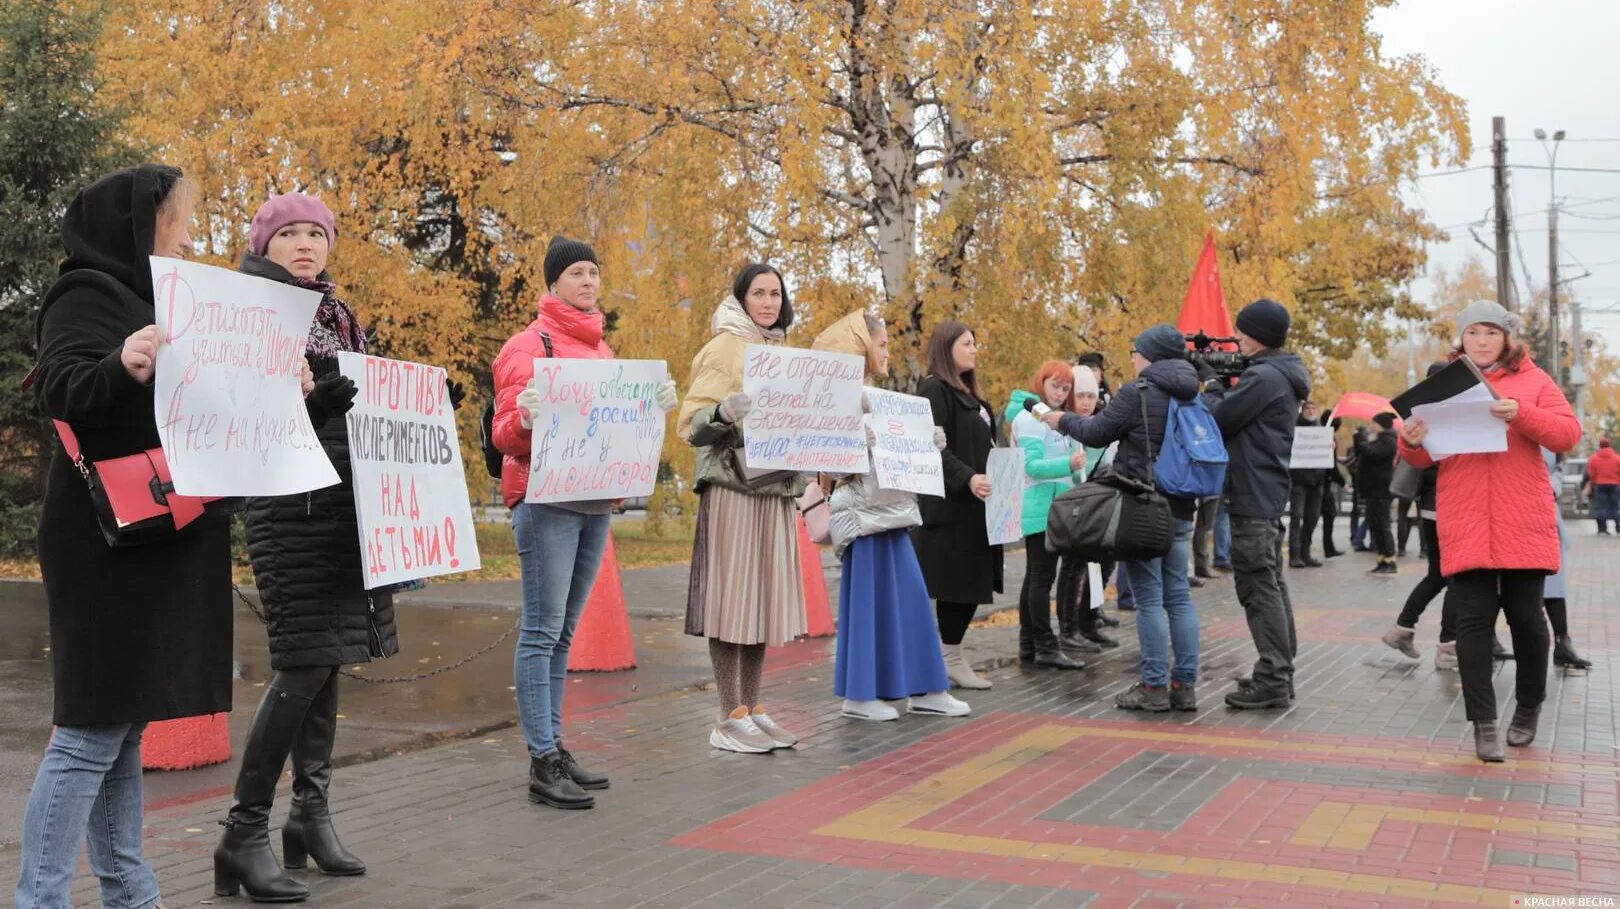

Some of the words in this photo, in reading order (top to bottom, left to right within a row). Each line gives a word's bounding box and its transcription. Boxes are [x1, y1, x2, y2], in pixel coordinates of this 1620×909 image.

[364, 356, 448, 417] ПРОТИВ!
[542, 365, 594, 417] Хочу
[748, 351, 782, 379] Не
[786, 356, 863, 395] отдадим
[380, 472, 420, 521] НАД
[367, 516, 460, 578] ДЕТЬМИ!
